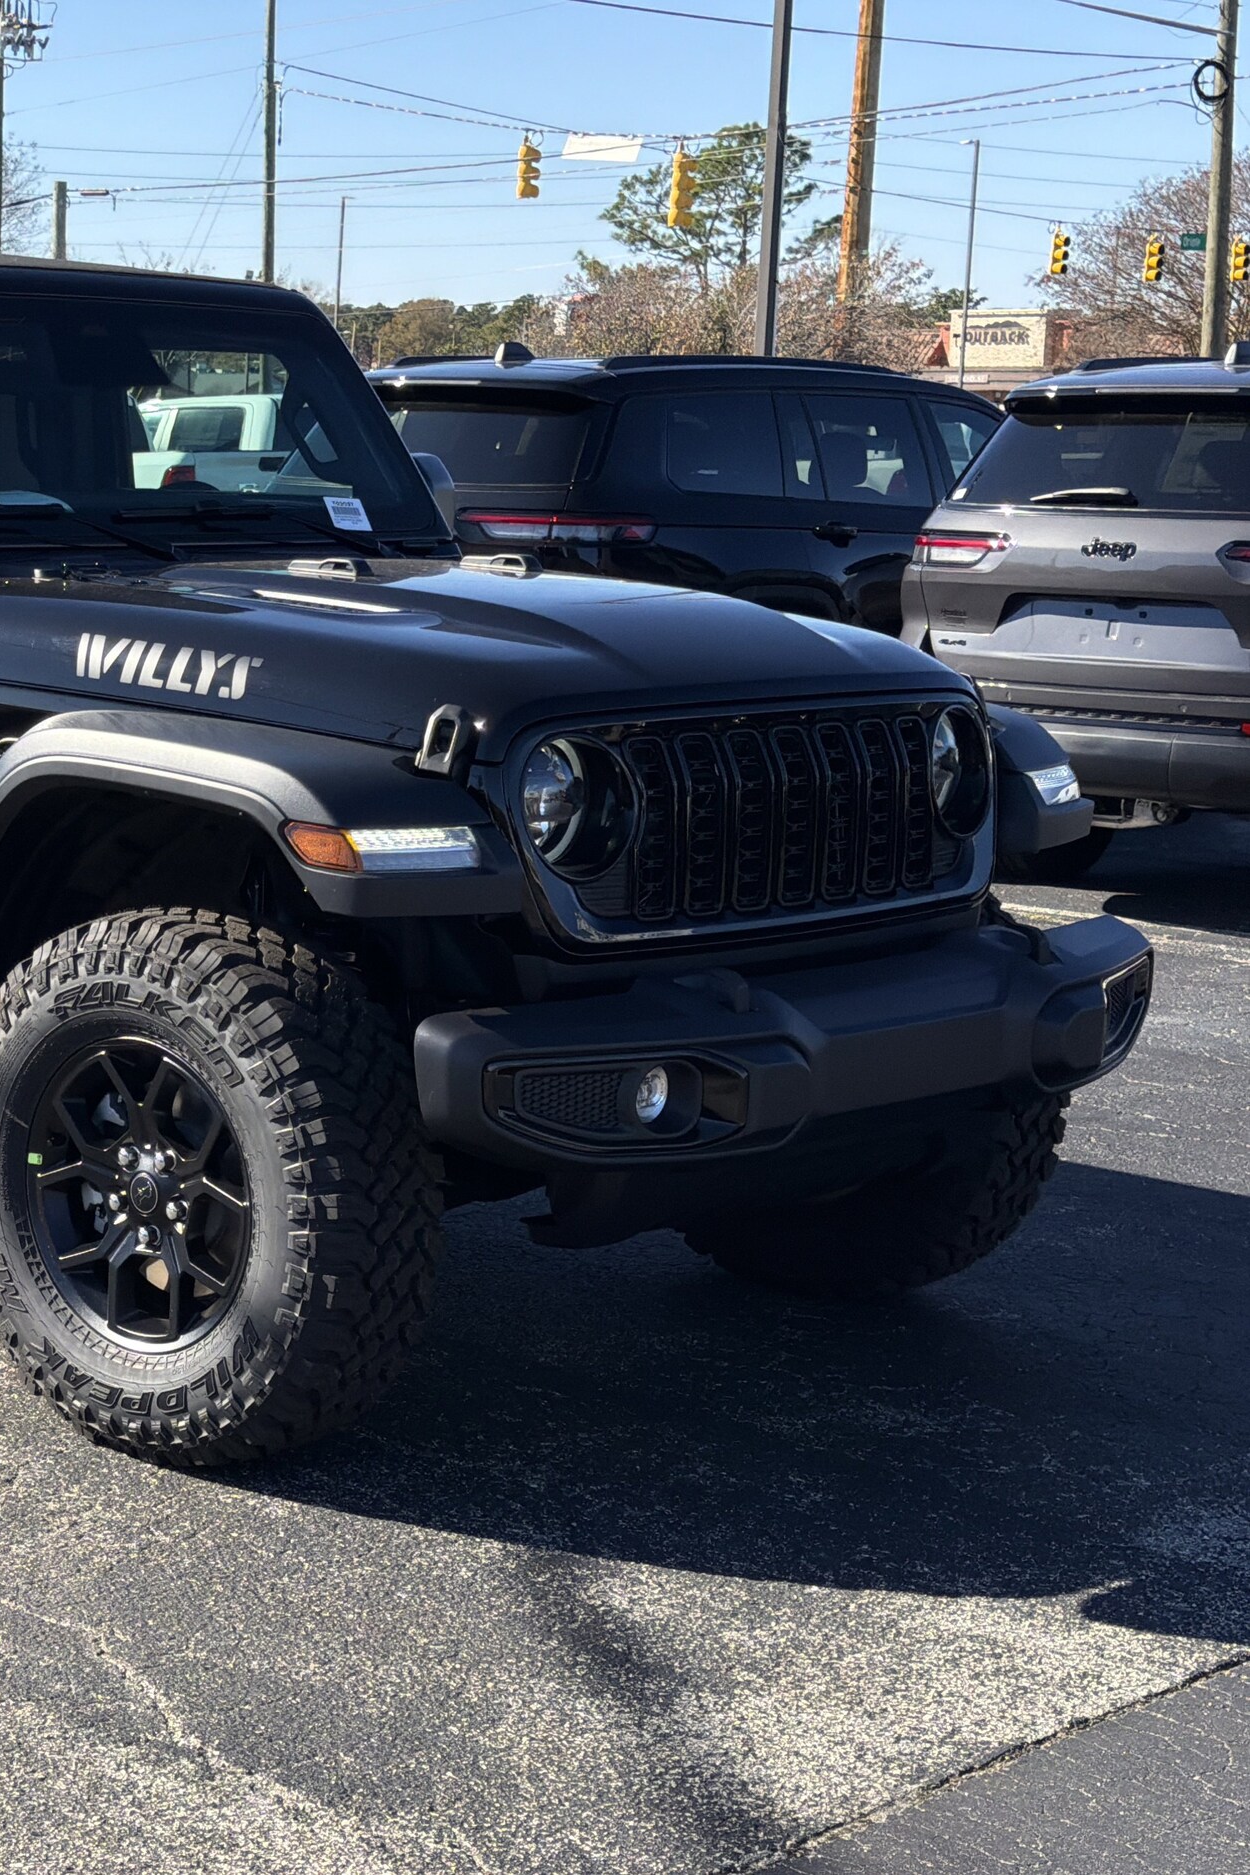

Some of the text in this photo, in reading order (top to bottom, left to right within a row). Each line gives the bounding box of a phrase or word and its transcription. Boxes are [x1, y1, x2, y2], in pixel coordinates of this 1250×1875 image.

[964, 330, 1030, 346] OUTBACK
[1081, 536, 1137, 561] Jeep
[75, 632, 264, 700] WILLYS
[28, 1316, 259, 1416] WILDPEAK
